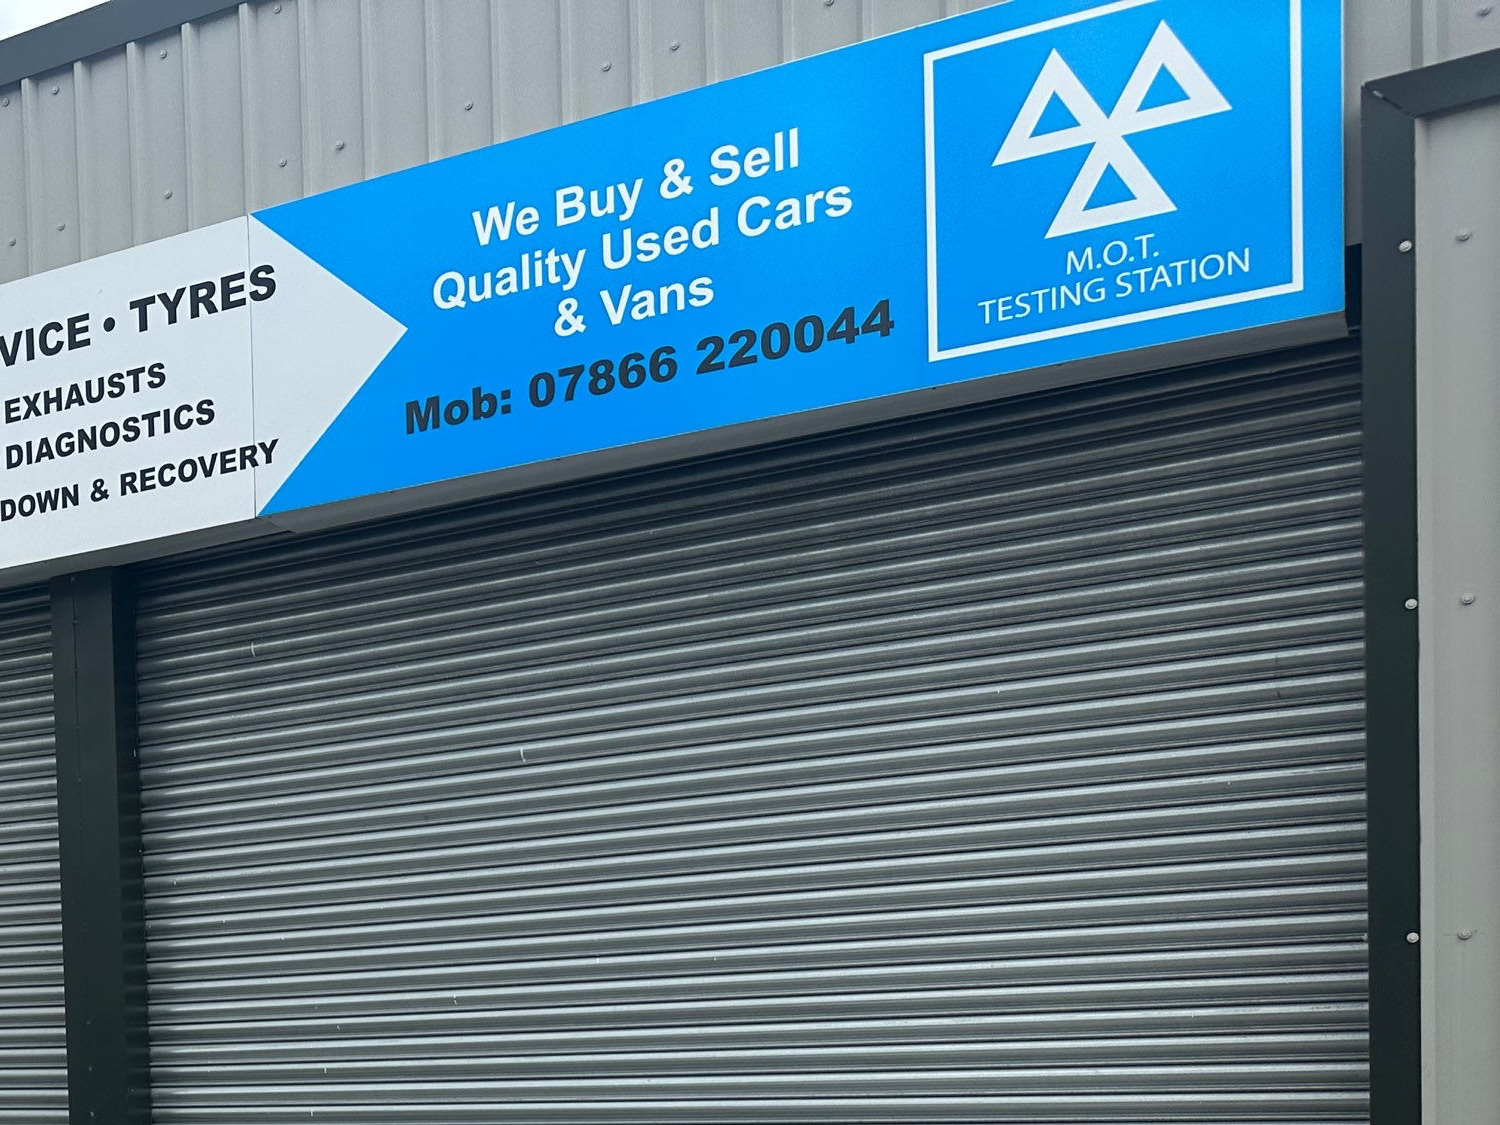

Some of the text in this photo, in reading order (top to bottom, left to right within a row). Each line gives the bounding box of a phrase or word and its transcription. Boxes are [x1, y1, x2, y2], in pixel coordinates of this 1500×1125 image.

[471, 127, 800, 247] We Buy & Sell
[432, 184, 854, 311] Quality Used Cars
[1065, 233, 1160, 275] M.O.T.
[129, 264, 277, 333] TYRES
[553, 276, 715, 337] & Vans
[978, 247, 1251, 325] TESTING STATION
[4, 362, 166, 424] EXHAUSTS
[405, 298, 895, 435] Mob: 07866 220044
[5, 398, 216, 471] DIAGNOSTICS
[90, 478, 110, 503] &
[120, 438, 279, 497] RECOVERY
